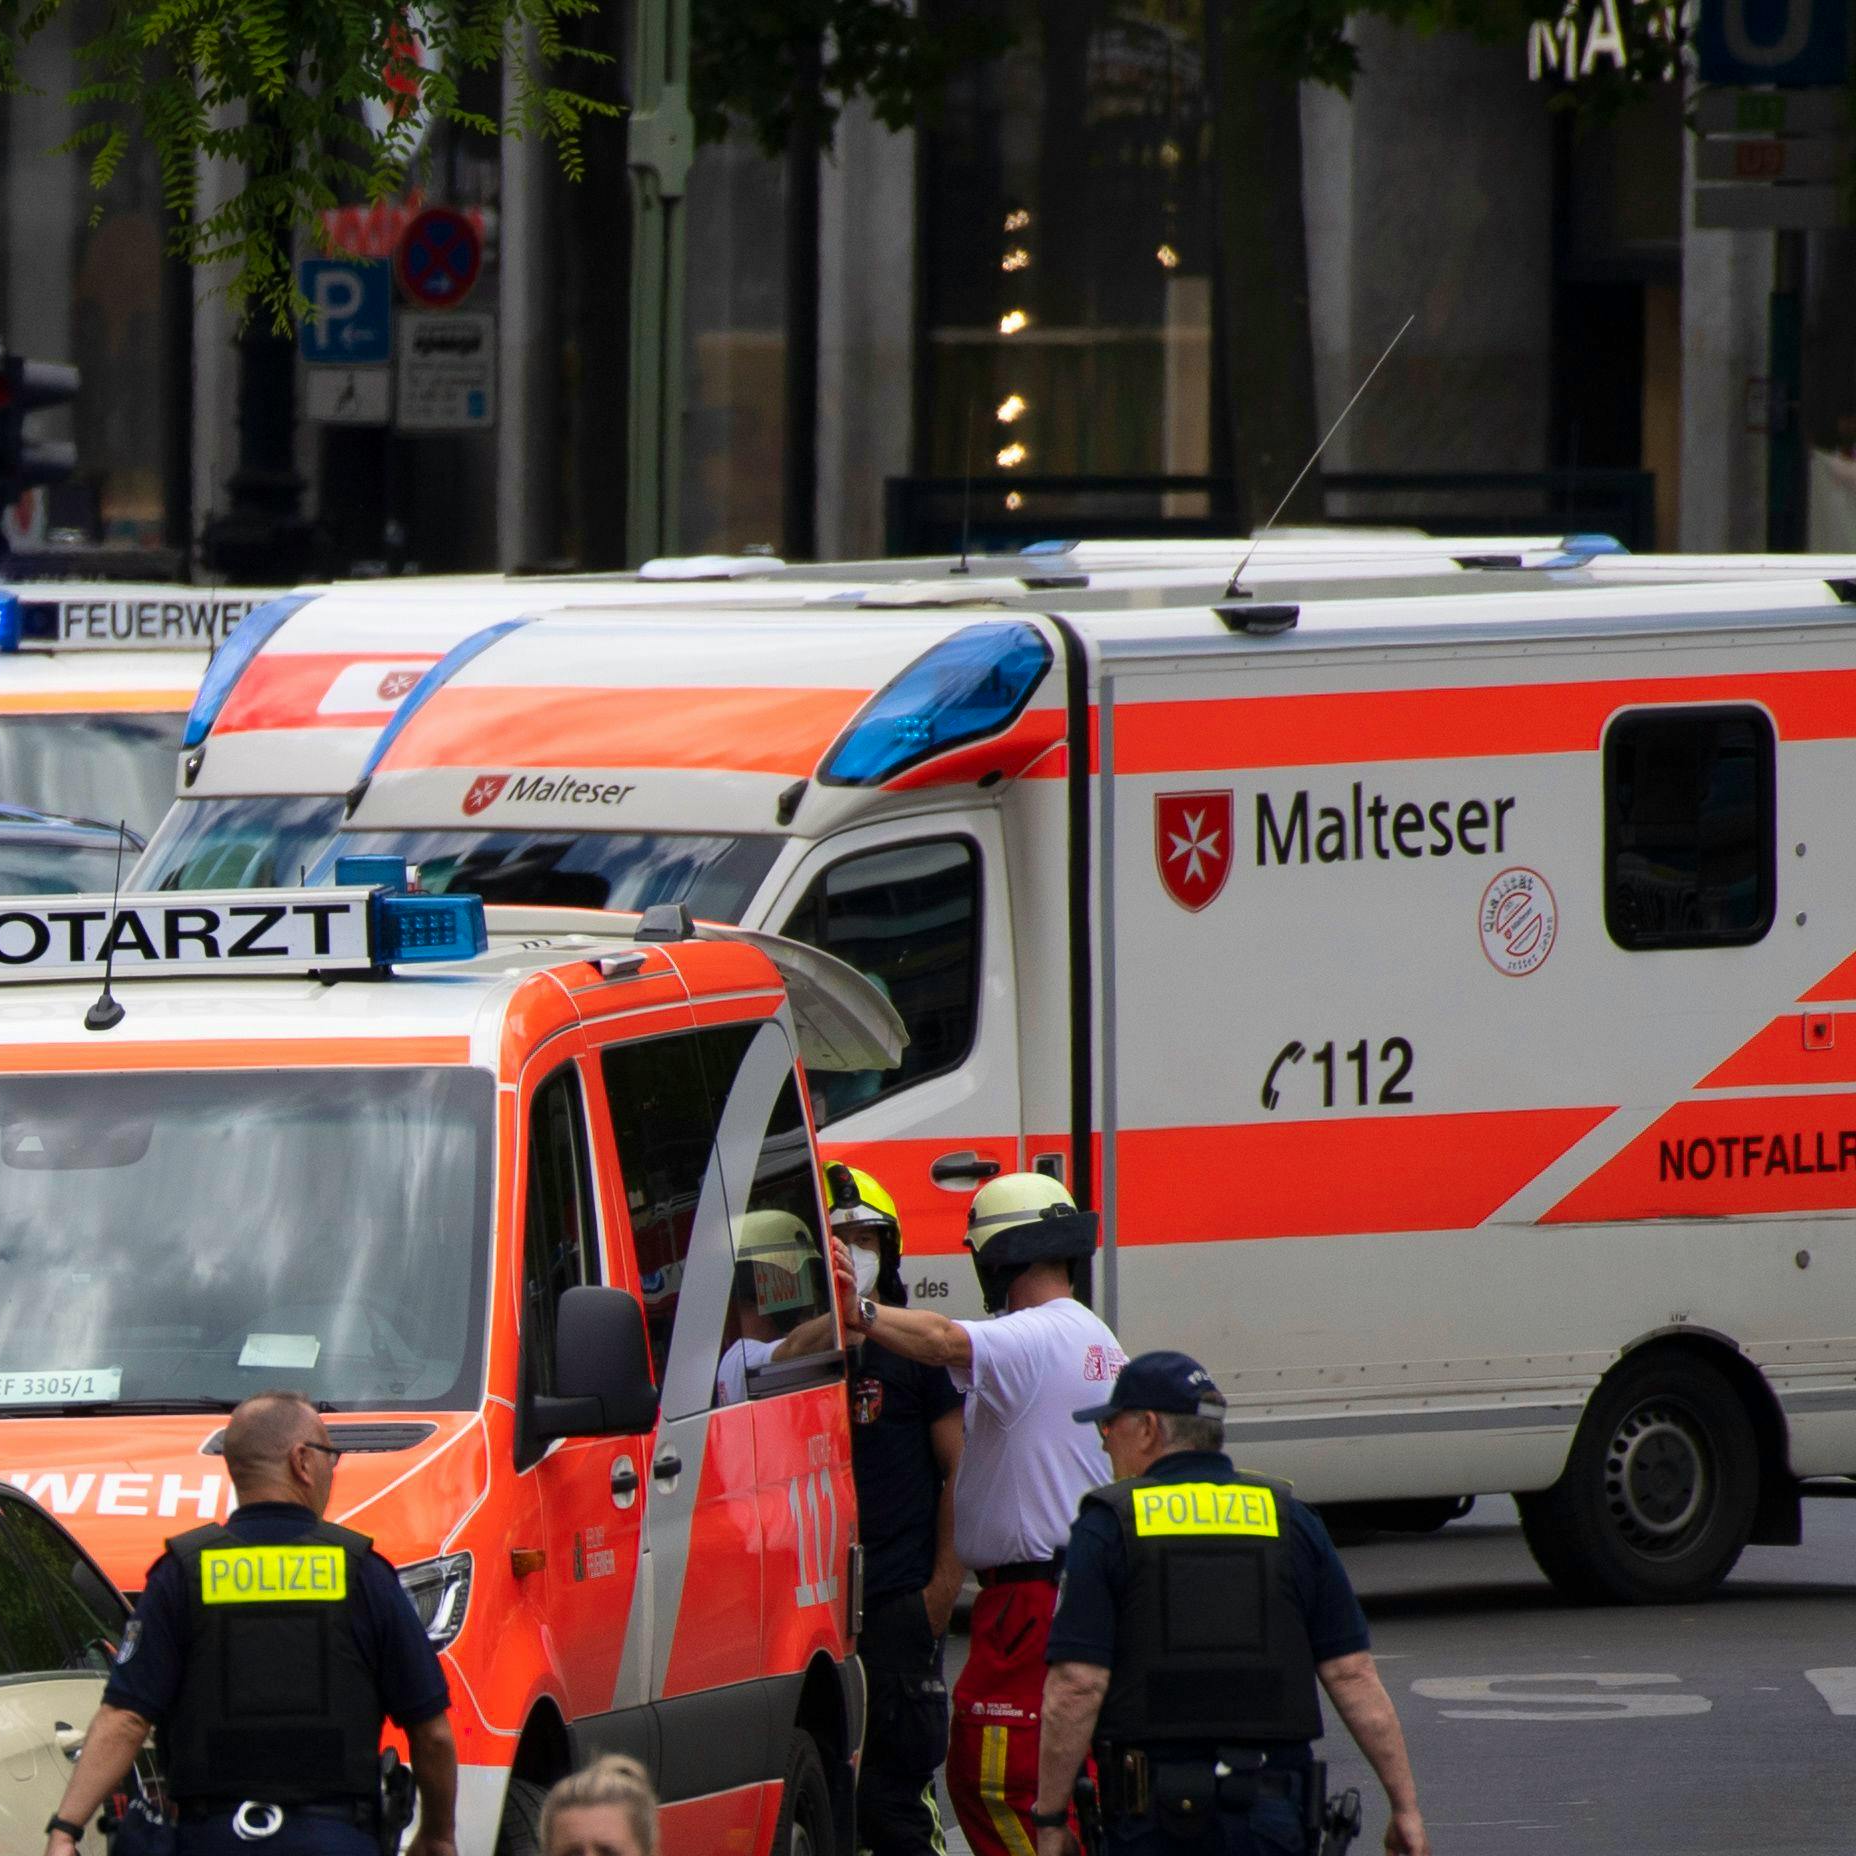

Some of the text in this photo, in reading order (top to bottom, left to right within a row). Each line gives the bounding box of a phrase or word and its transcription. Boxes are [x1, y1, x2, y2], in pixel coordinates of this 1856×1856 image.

[64, 602, 254, 639] FEUERWE
[506, 775, 637, 805] Malteser
[1256, 781, 1516, 867] Malteser
[1313, 1036, 1414, 1108] 112
[915, 1276, 949, 1299] des
[23, 1376, 95, 1397] 3305/1
[1143, 1491, 1270, 1528] POLIZEI
[210, 1554, 339, 1594] POLIZEI
